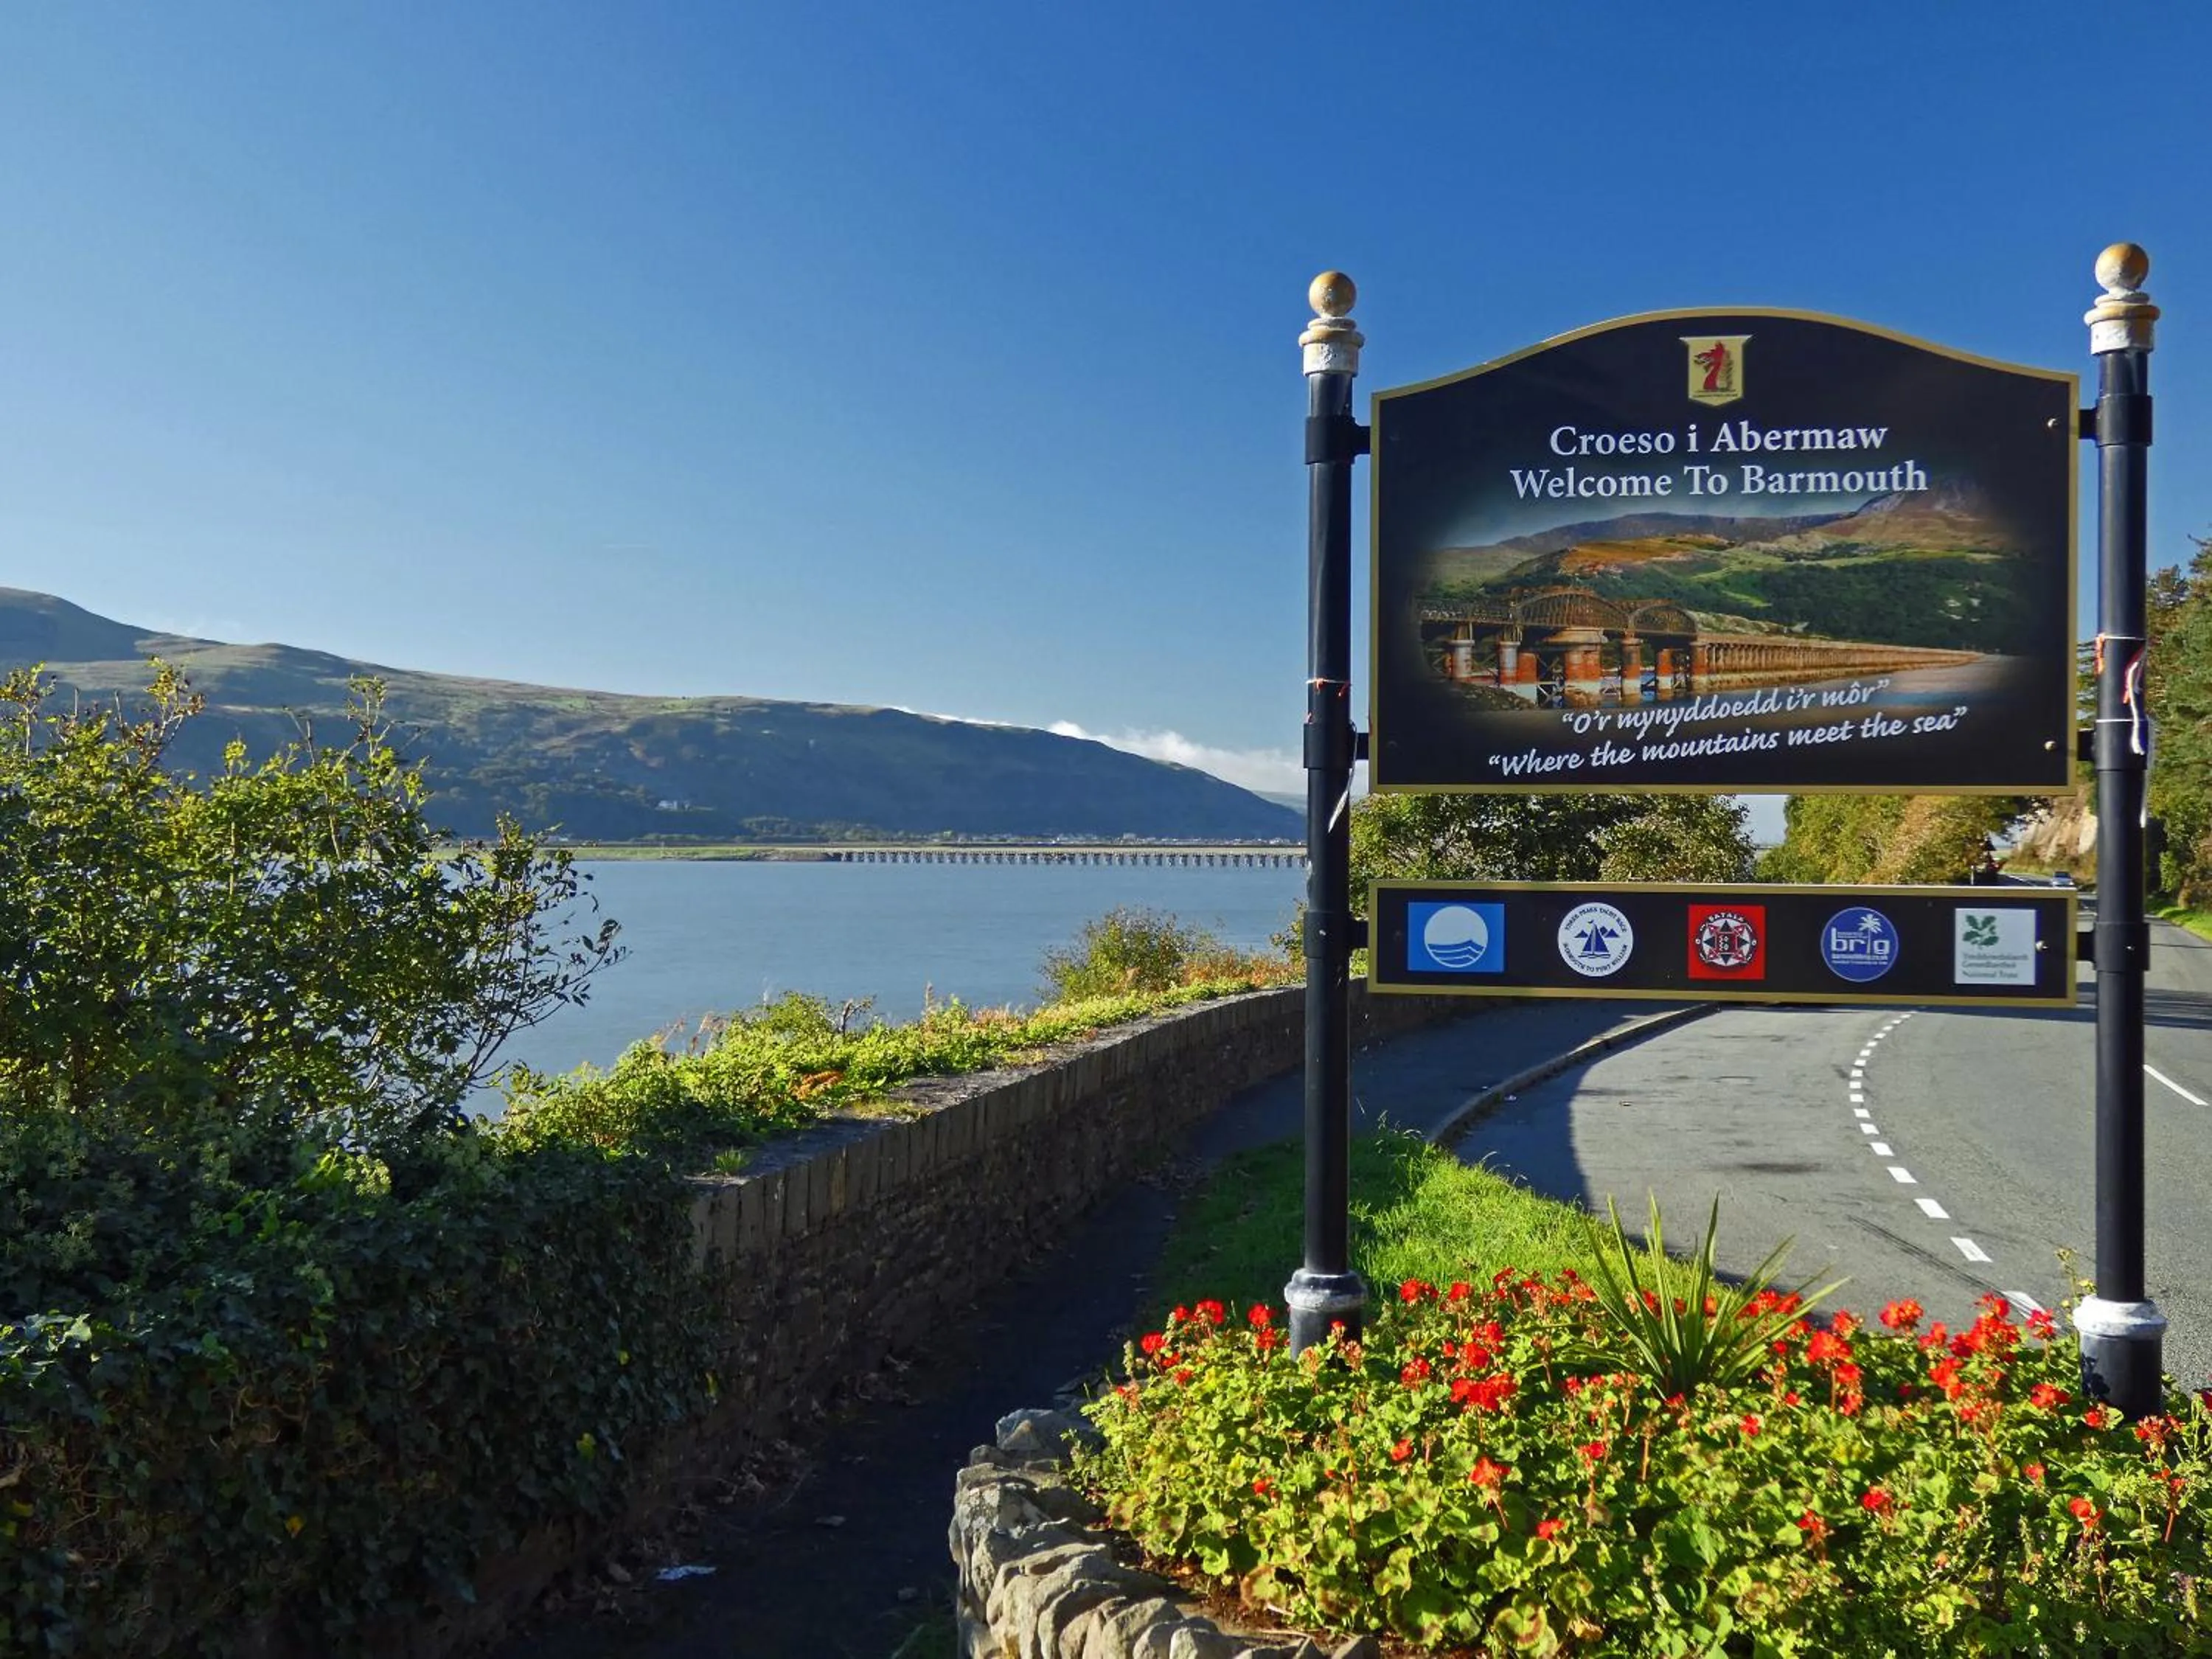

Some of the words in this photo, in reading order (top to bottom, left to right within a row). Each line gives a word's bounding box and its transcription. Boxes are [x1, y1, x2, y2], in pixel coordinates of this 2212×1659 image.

[1550, 425, 1675, 456] Croeso
[1686, 423, 1698, 453] i
[1710, 420, 1888, 453] Abermaw
[1509, 467, 1672, 499] Welcome
[1683, 465, 1728, 495] To
[1740, 459, 1929, 495] Barmouth
[1618, 690, 1782, 740] mynyddoedd
[1590, 740, 1635, 768] the
[1642, 727, 1781, 762] mountains
[1787, 720, 1855, 746] meet
[1860, 712, 1908, 739] the
